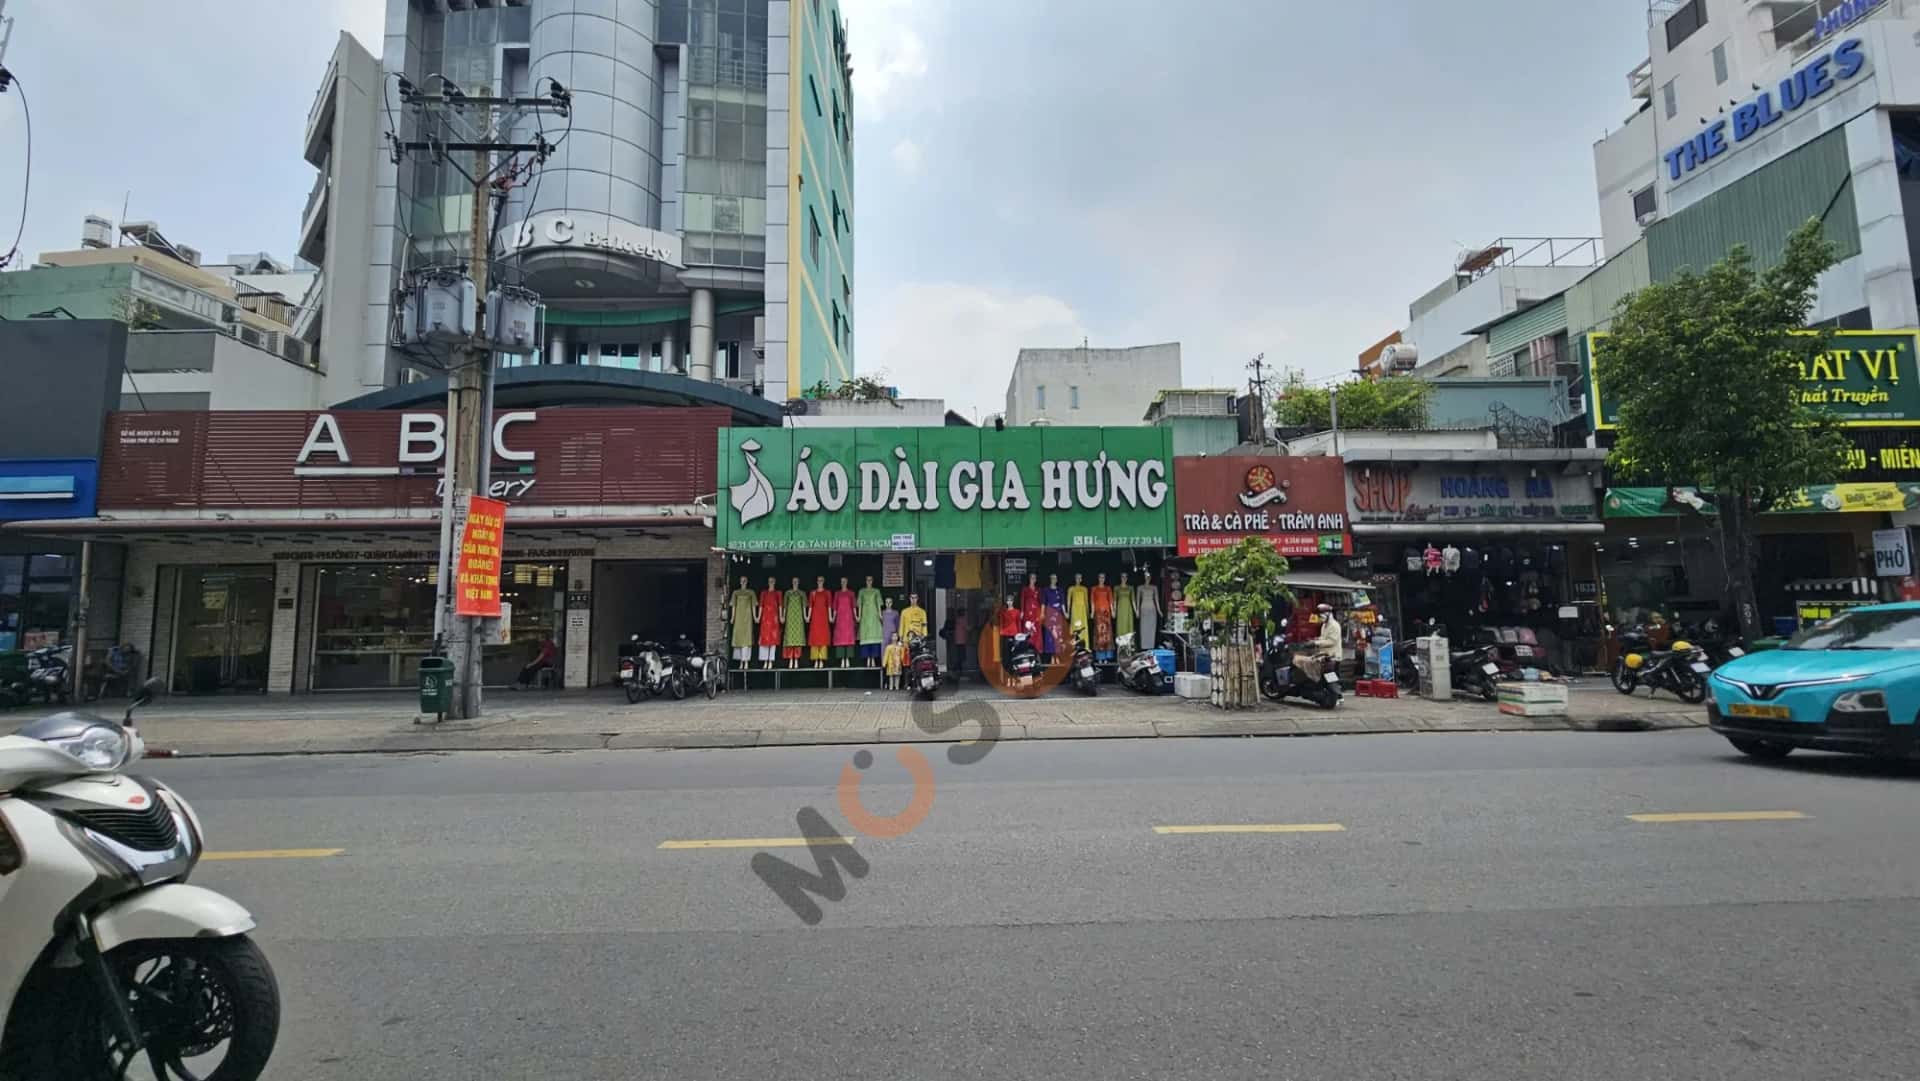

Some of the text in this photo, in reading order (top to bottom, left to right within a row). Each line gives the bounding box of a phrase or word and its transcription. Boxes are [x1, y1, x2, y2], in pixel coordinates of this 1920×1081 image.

[1664, 38, 1864, 180] THE BLUES
[583, 231, 673, 262] Bakery
[1858, 349, 1900, 386] VỊ
[786, 446, 1169, 512] ÁO DÀI GIA HƯNG
[1353, 468, 1412, 513] SHOP
[1183, 508, 1210, 530] TRÀ
[1211, 514, 1223, 530] &
[1224, 509, 1242, 530] CÀ
[1244, 509, 1270, 530] PHÊ
[1279, 509, 1315, 530] TRÂM
[1317, 512, 1344, 530] ANH
[1876, 543, 1905, 569] PHỞ
